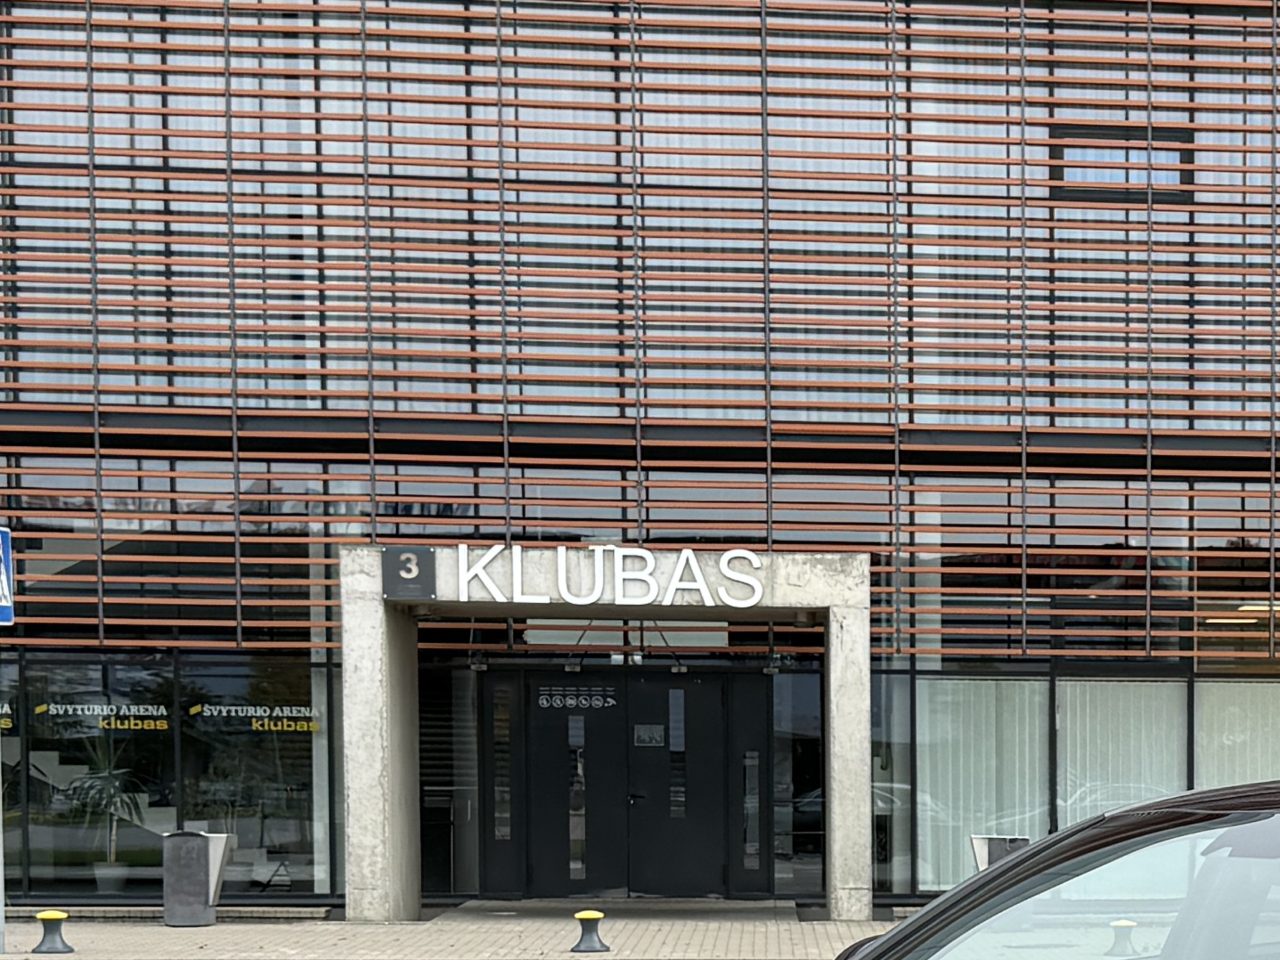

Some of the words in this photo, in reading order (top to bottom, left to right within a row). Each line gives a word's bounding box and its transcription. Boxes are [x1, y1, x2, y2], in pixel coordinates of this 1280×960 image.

[399, 552, 419, 579] 3
[458, 543, 764, 608] KLUBAS
[48, 704, 117, 716] ŠVYTURIO
[119, 704, 168, 716] ARENA
[202, 704, 271, 717] ŠVYTURIO
[272, 705, 320, 717] ARENA
[98, 716, 169, 730] klubas
[251, 717, 320, 732] klubas
